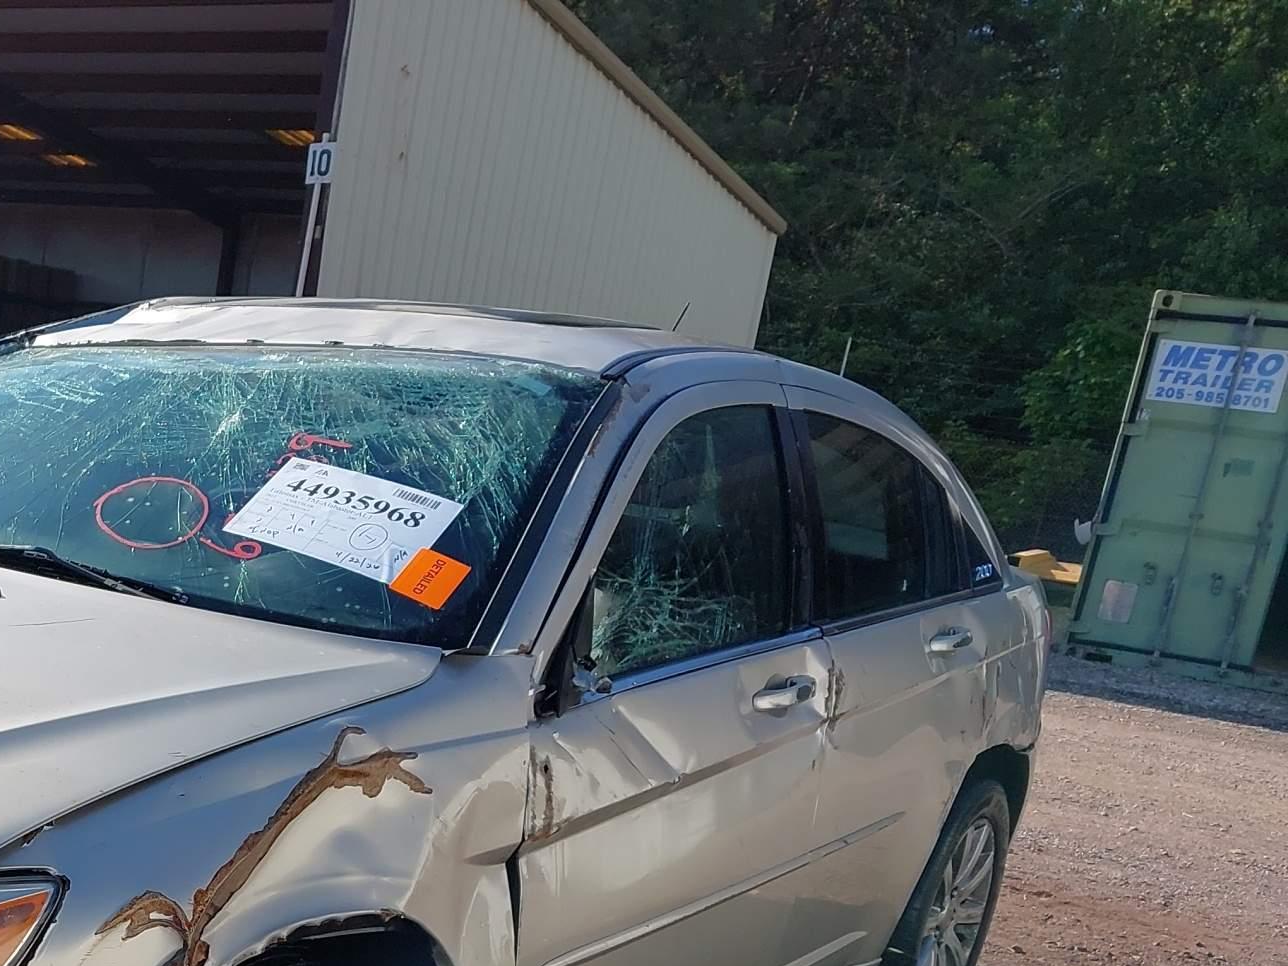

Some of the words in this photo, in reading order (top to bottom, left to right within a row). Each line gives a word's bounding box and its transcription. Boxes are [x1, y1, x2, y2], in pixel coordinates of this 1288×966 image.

[310, 150, 332, 177] 10
[1162, 344, 1285, 377] METRO
[1158, 369, 1275, 394] TRAILER
[1154, 386, 1271, 409] 205-9858701
[286, 478, 426, 528] 44935968
[413, 558, 447, 596] DETAILED
